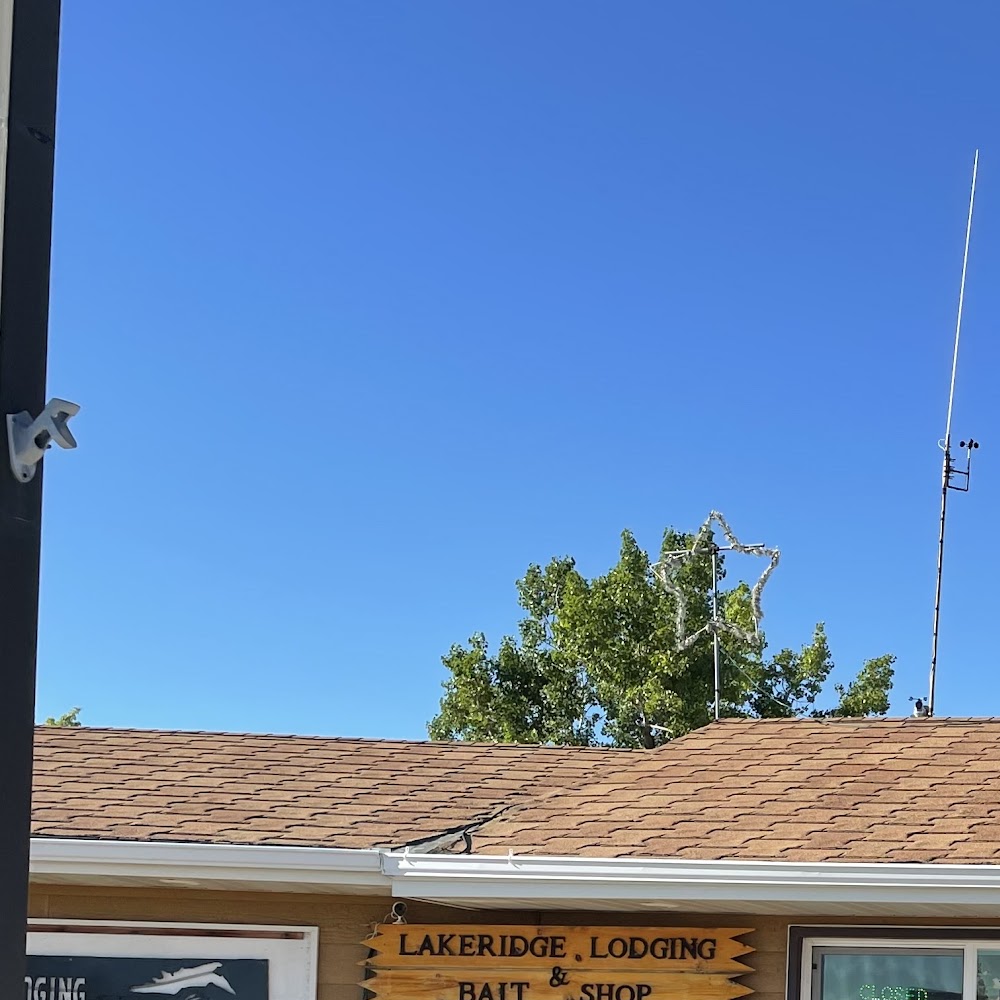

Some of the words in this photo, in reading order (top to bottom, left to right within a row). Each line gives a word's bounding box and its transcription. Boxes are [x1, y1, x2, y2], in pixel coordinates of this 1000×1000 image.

[398, 933, 566, 959] LAKERIDGE
[590, 936, 717, 961] LODGING
[549, 966, 569, 987] &
